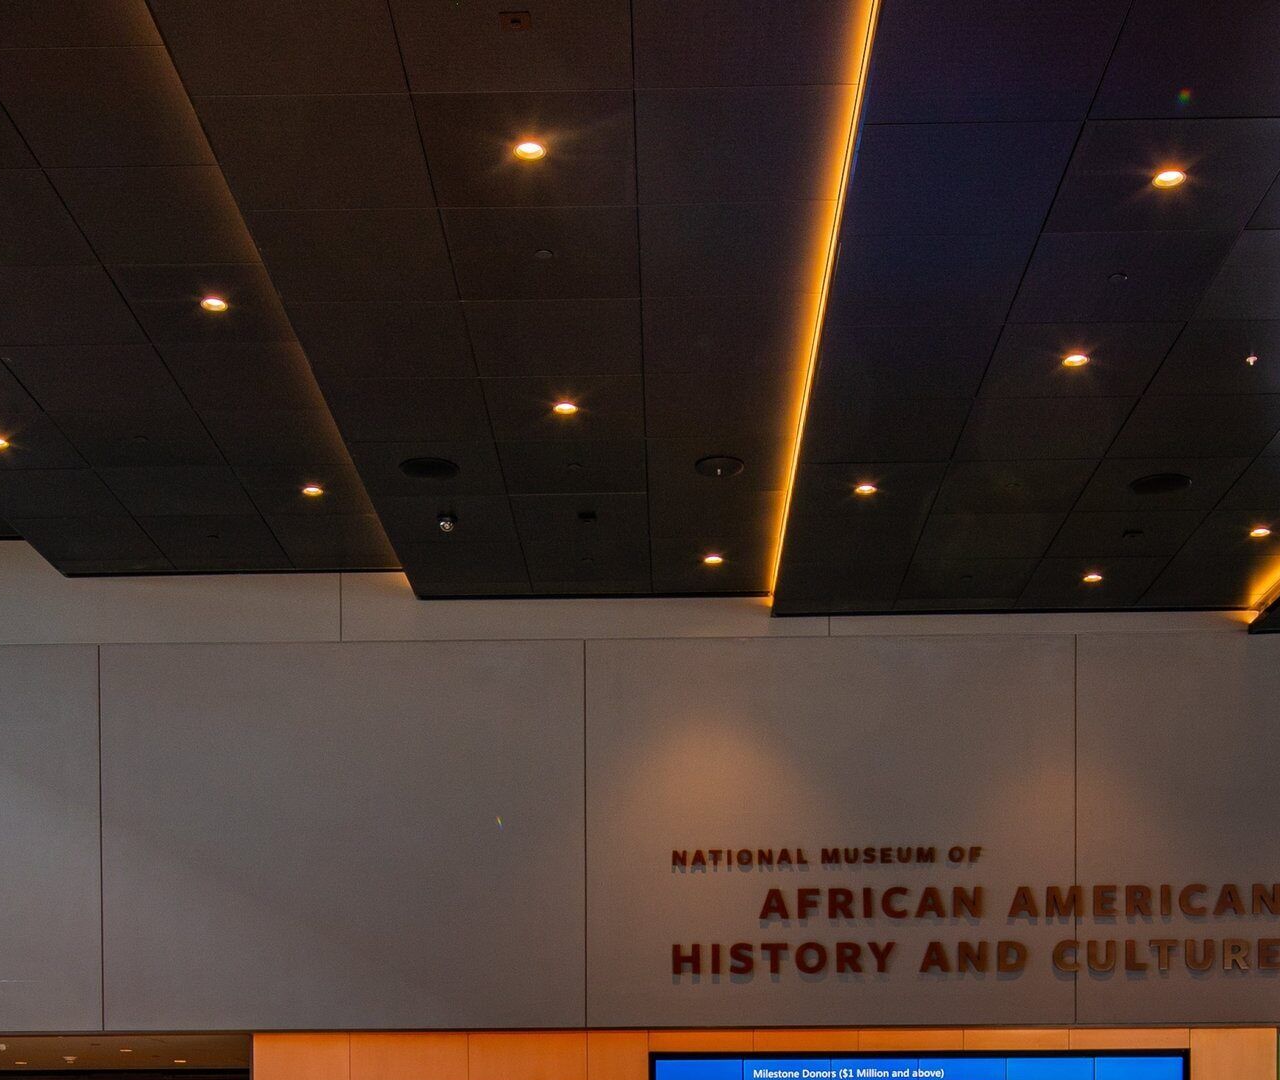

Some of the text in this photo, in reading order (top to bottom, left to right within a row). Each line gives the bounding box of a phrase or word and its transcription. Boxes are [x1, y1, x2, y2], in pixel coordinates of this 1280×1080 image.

[672, 847, 983, 868] NATIONAL MUSEUM OF
[760, 886, 983, 920] AFRICAN
[672, 942, 896, 975] HISTORY
[921, 941, 1027, 974] AND
[753, 1068, 944, 1079] Milestone Donors ($1 Million and above)
